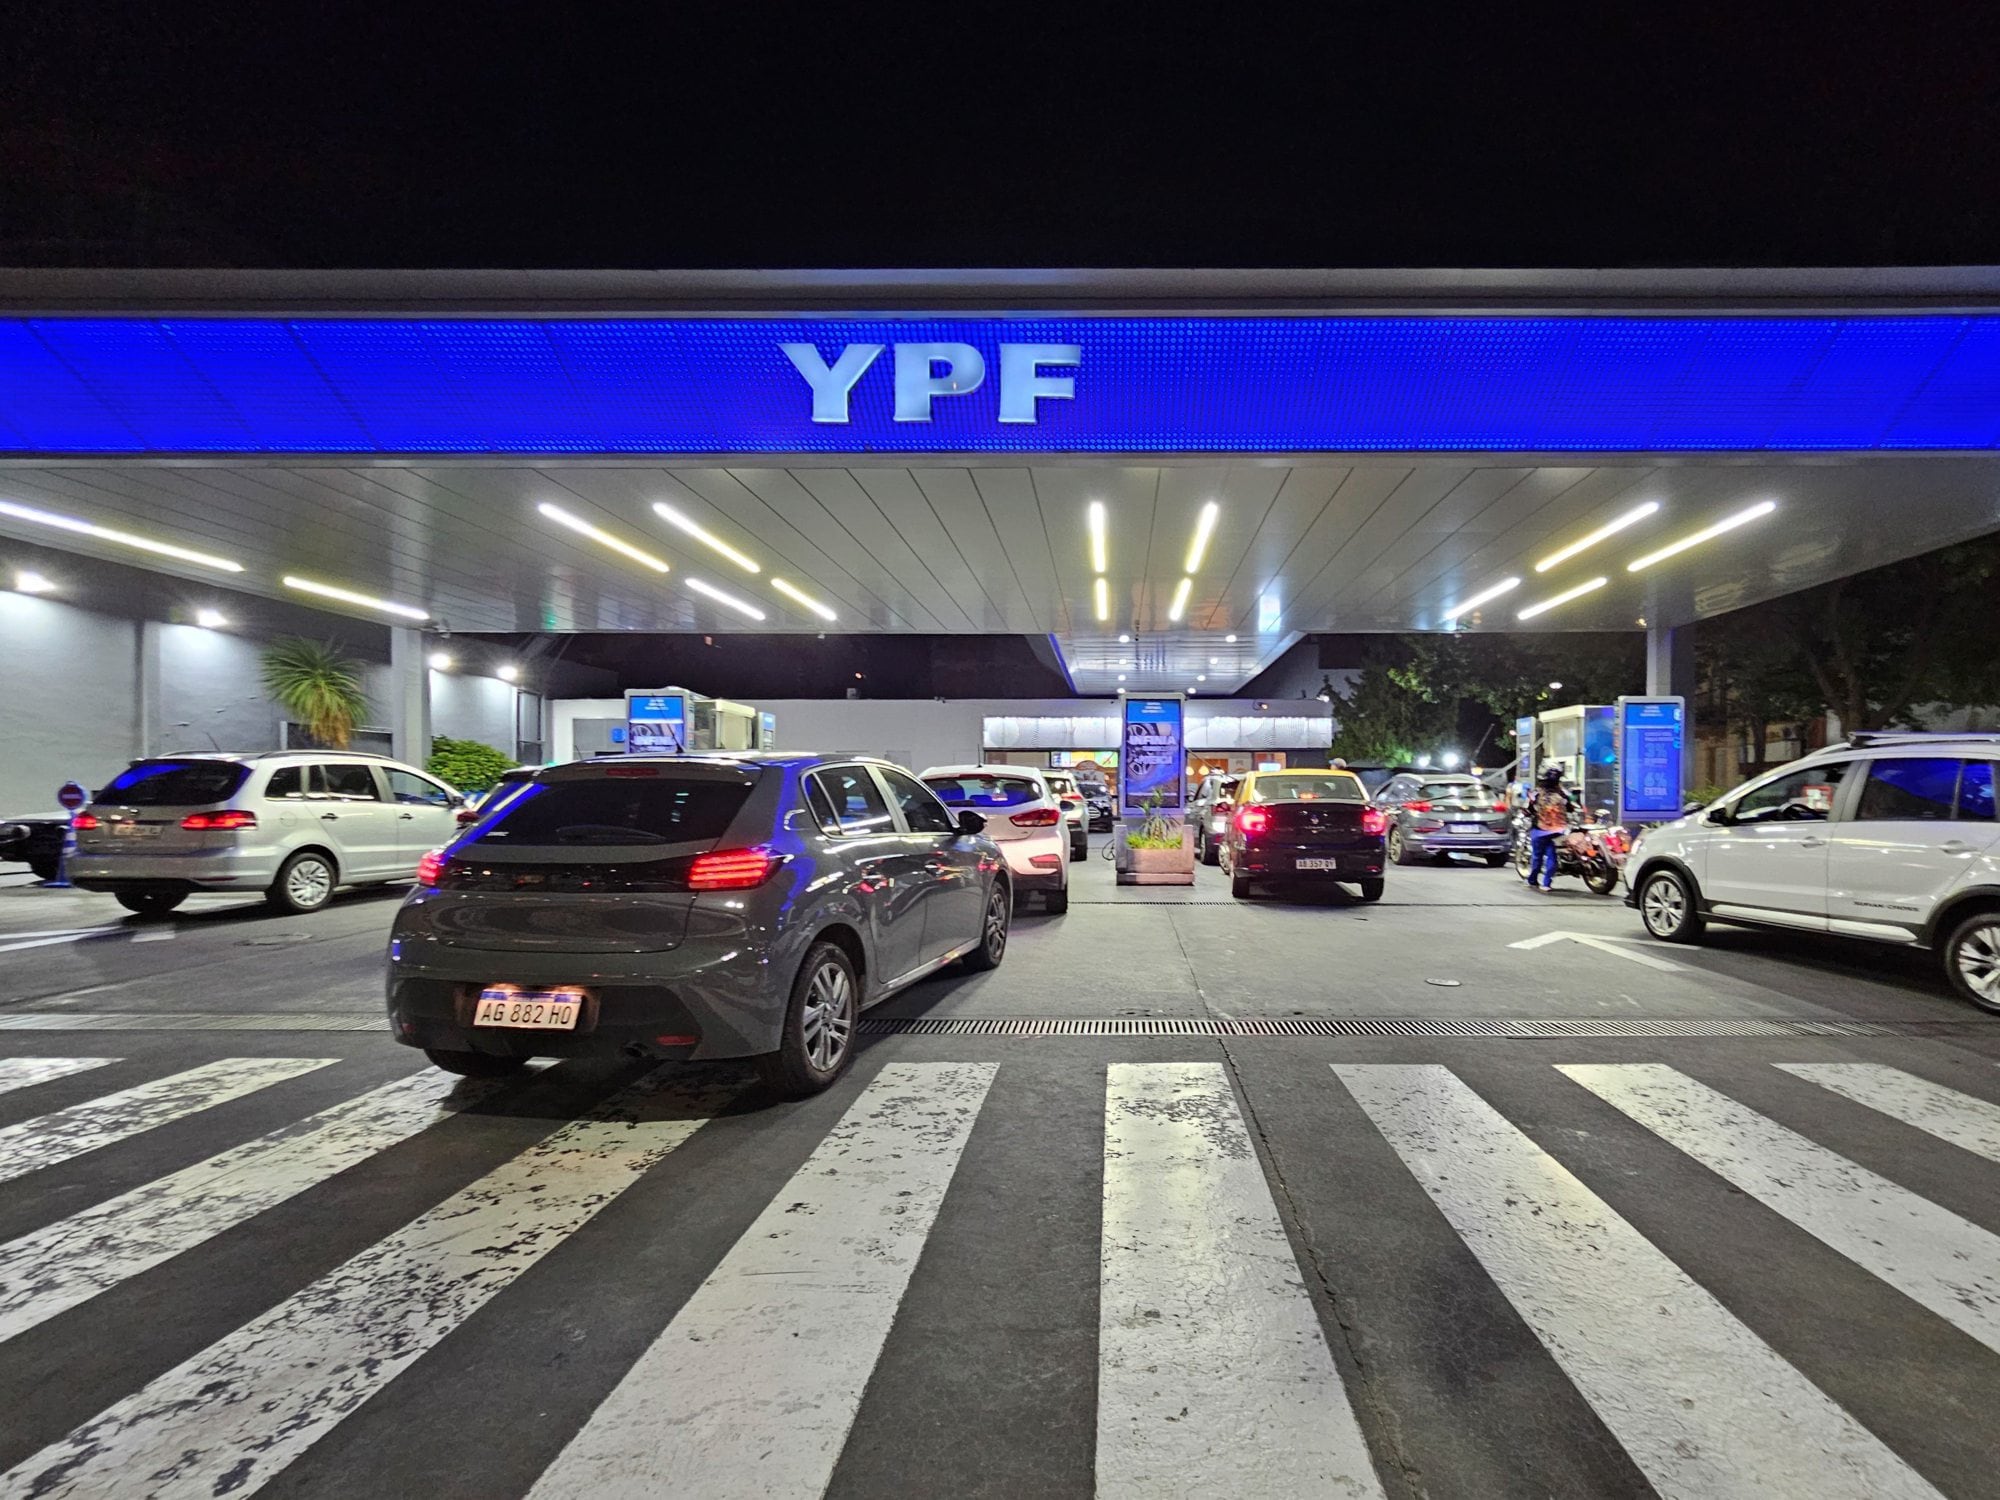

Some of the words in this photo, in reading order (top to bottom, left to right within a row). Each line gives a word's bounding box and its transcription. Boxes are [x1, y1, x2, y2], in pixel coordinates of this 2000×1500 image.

[776, 342, 1081, 423] YPF
[481, 1002, 506, 1022] AG
[510, 1004, 544, 1024] 882
